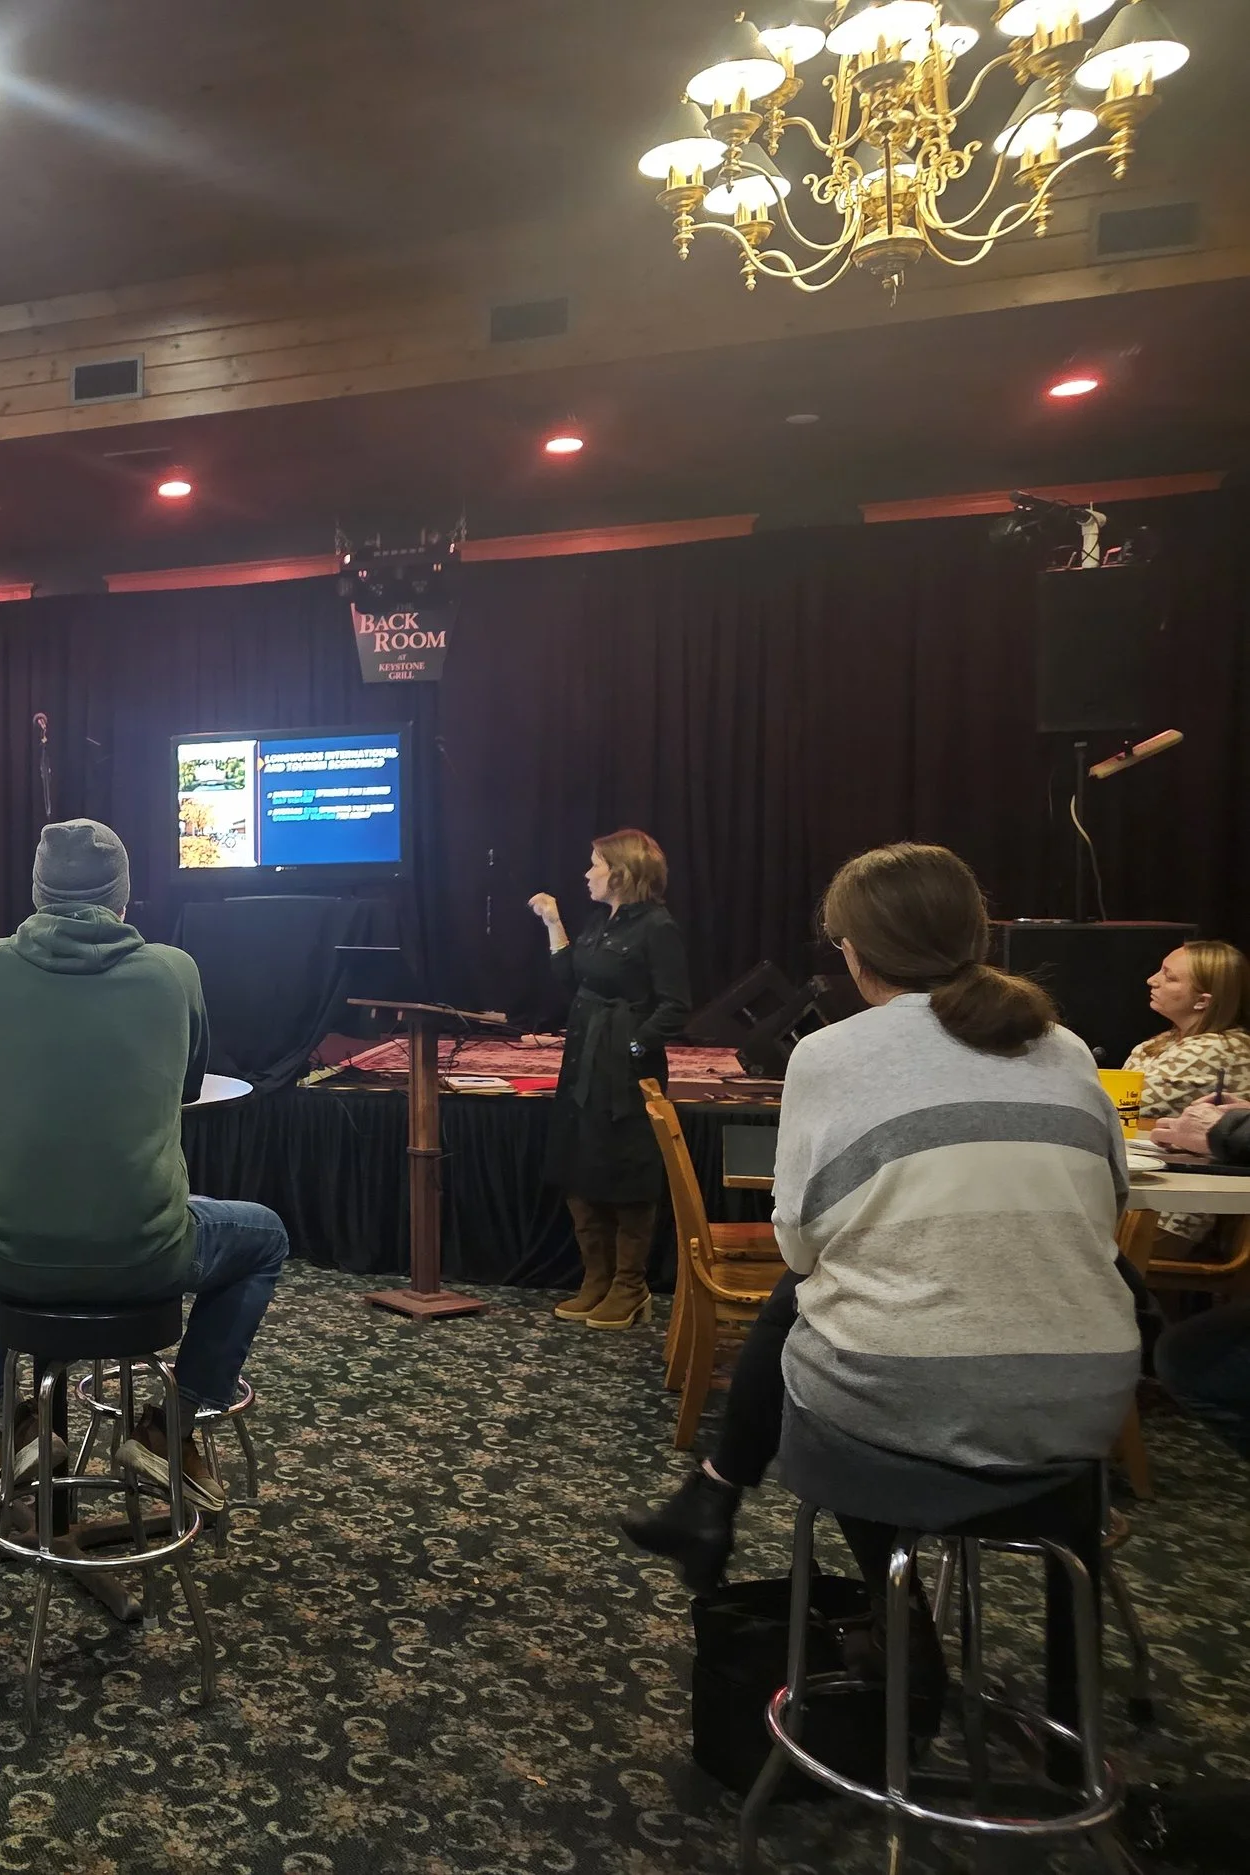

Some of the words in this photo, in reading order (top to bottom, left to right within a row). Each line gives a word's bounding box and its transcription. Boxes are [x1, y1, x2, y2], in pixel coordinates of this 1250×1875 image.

[359, 612, 419, 633] BACK
[374, 631, 446, 652] ROOM
[378, 661, 426, 672] KEYSTONE
[388, 671, 415, 680] GRILL
